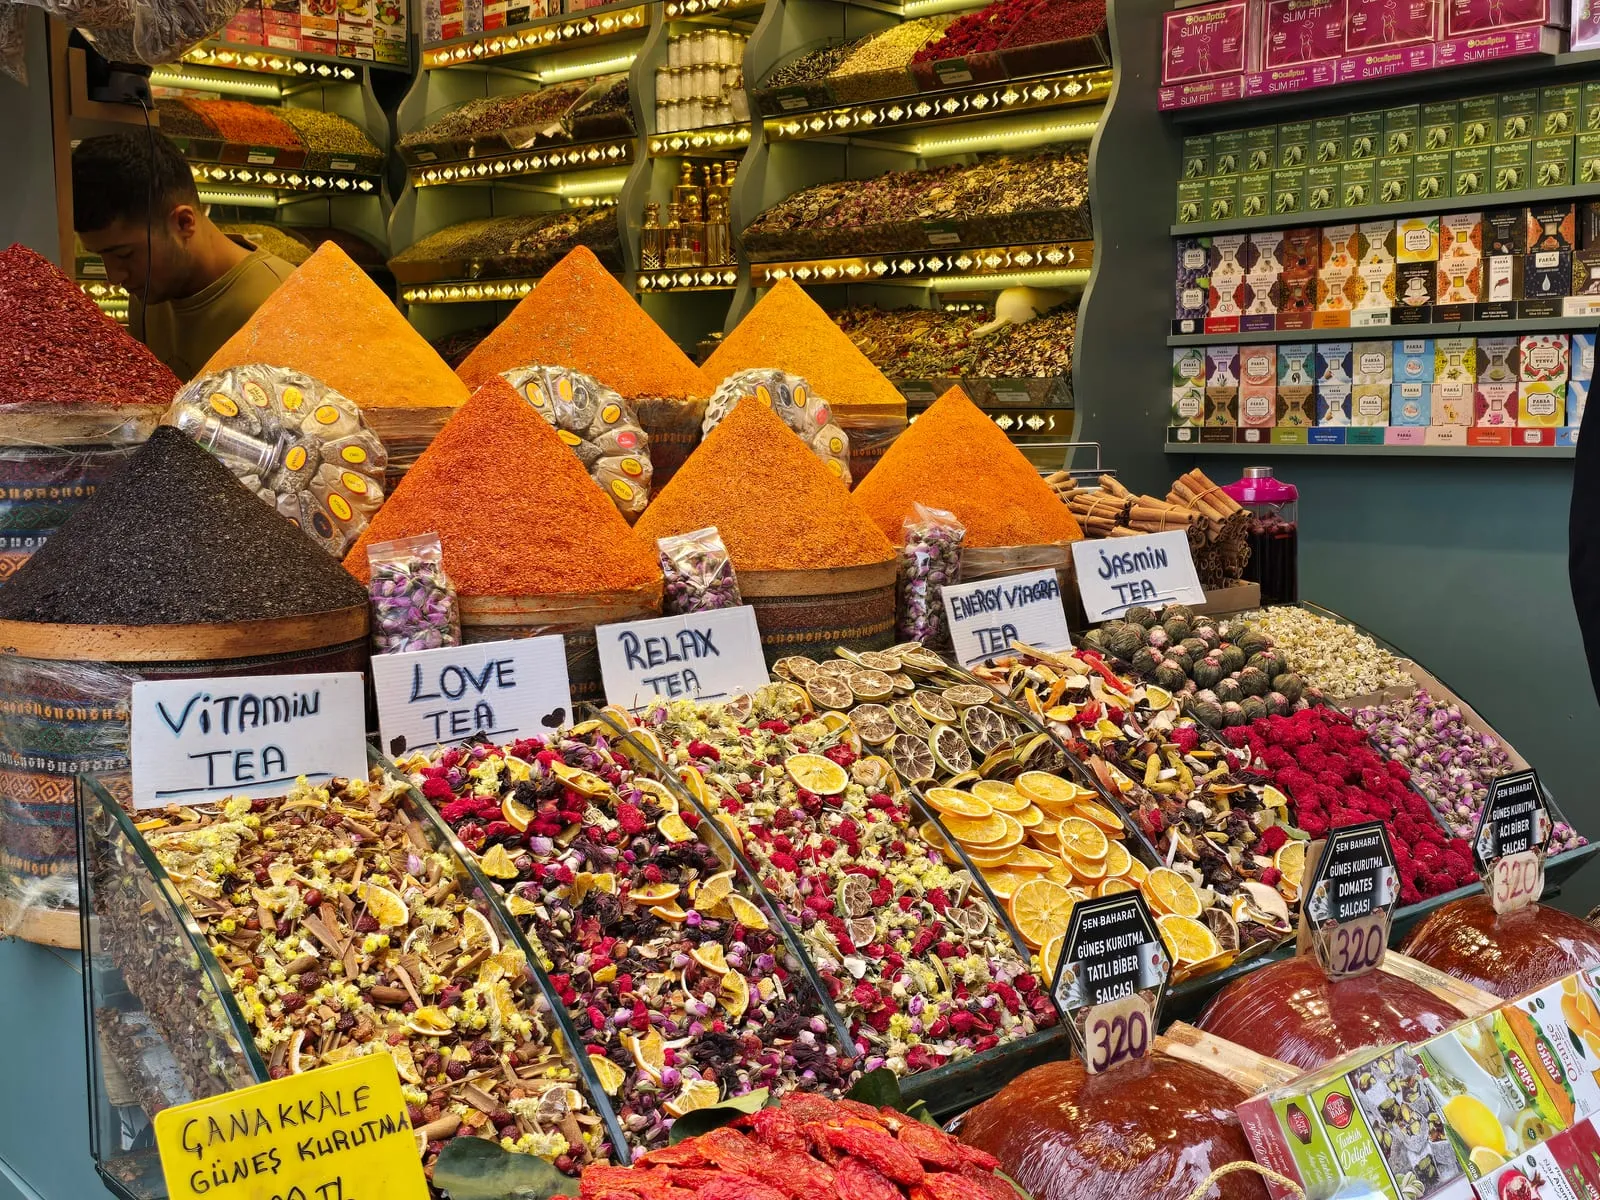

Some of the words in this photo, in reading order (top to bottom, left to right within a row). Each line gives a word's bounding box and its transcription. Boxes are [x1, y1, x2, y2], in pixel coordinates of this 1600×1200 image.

[1181, 25, 1204, 38] SLIM
[1282, 11, 1306, 24] SLIM
[1463, 49, 1485, 61] SLIM
[1362, 66, 1383, 77] SLIM
[1180, 95, 1198, 105] SLIM
[1268, 82, 1288, 92] SLIM
[951, 585, 1004, 622] ENERGY
[1111, 579, 1158, 605] TEA
[618, 627, 720, 671] RELAX
[972, 624, 1020, 654] TEA
[409, 658, 517, 704] LOVE
[642, 668, 702, 699] TEA
[423, 700, 498, 739] TEA
[188, 745, 288, 788] TEA
[1509, 782, 1532, 796] BAHARAT
[1336, 841, 1349, 855] ŞEN
[1350, 835, 1380, 850] BAHARAT
[1330, 860, 1351, 878] GÜNEŞ
[1352, 856, 1383, 874] KURUTMA
[1497, 861, 1536, 902] 320
[1339, 877, 1373, 897] DOMATES
[1082, 919, 1099, 933] ŞEN
[1100, 908, 1137, 926] BAHARAT
[1340, 898, 1370, 919] SALÇASI
[1077, 939, 1105, 960] GÜNEŞ
[1106, 930, 1145, 952] KURUTMA
[1332, 924, 1382, 976] 320
[1087, 961, 1111, 982] TATLI
[1113, 955, 1138, 976] BİBER
[1092, 1010, 1148, 1073] 320
[1547, 1024, 1577, 1081] Orange
[1490, 1052, 1524, 1110] Lemon
[1510, 1054, 1536, 1092] TURKO
[1327, 1097, 1345, 1112] SUPER
[1330, 1106, 1347, 1119] BABA
[182, 1085, 371, 1160] ÇANAKKALE
[189, 1147, 282, 1195] GÜNEŞ
[299, 1111, 409, 1161] KURUTMA
[1341, 1140, 1373, 1170] Delight
